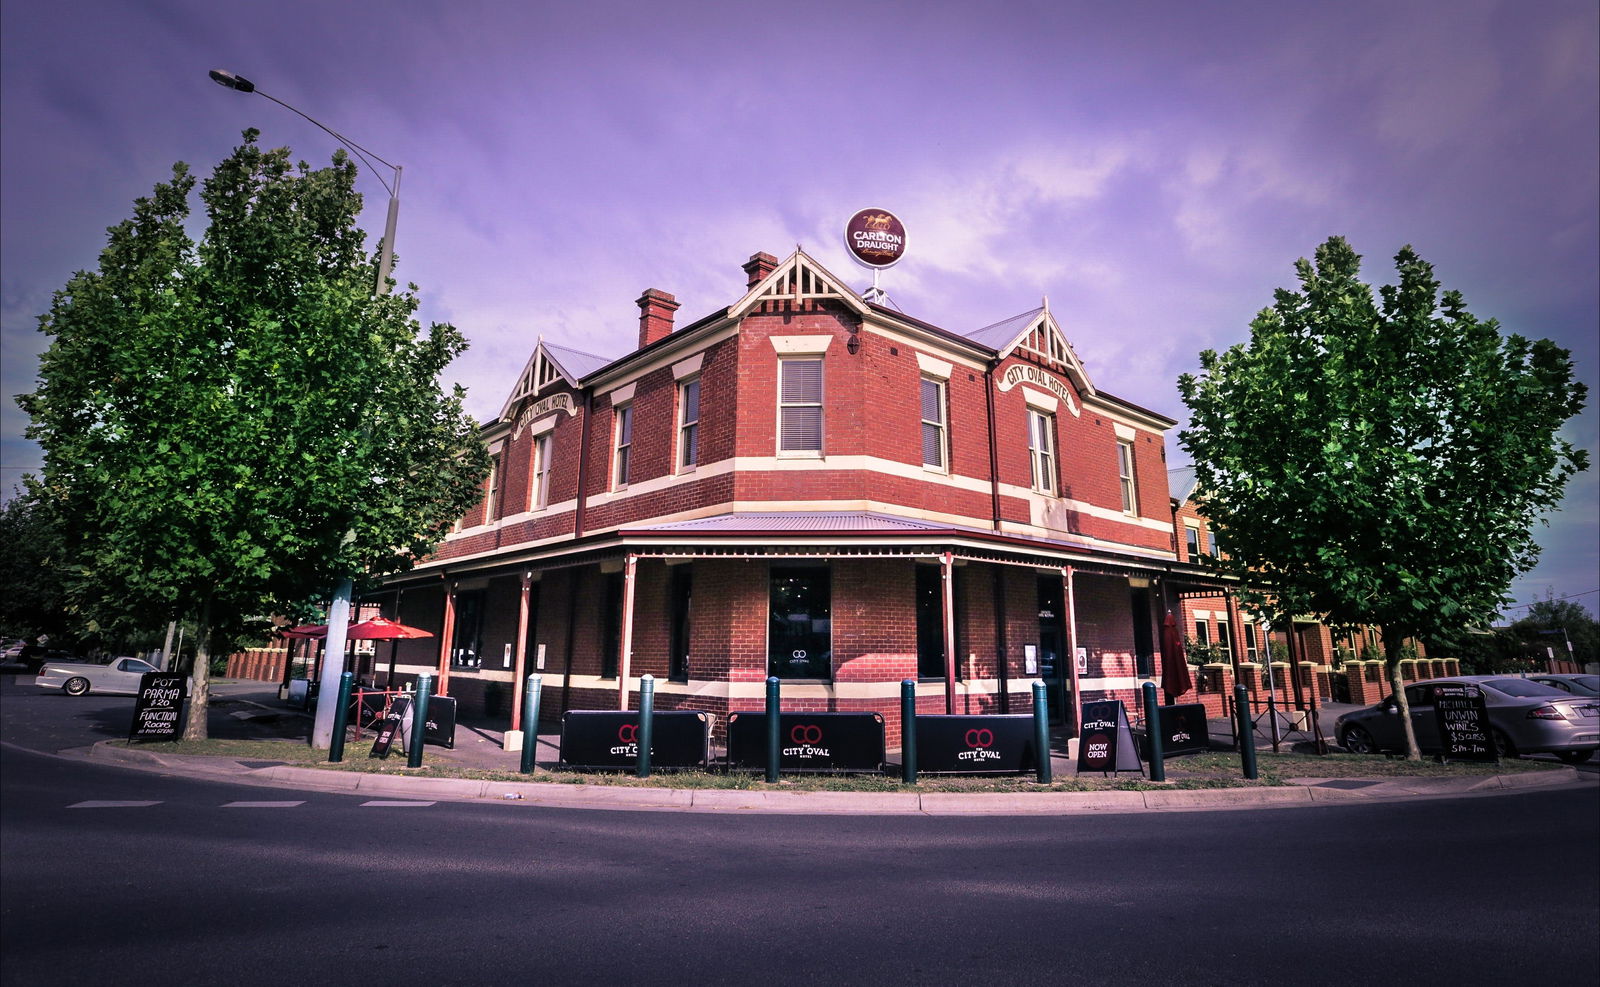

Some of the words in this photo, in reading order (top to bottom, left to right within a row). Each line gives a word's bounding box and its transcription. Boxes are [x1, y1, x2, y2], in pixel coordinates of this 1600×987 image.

[853, 230, 902, 245] CARLTON
[857, 240, 899, 251] DRAUGHT
[1007, 366, 1024, 386] CITY
[1027, 367, 1047, 387] OVAL
[1049, 376, 1070, 406] HOTEL
[520, 406, 533, 428] CITY
[536, 399, 550, 415] OVAL
[551, 394, 568, 409] HOTEL
[152, 678, 180, 687] POT
[144, 688, 180, 700] PARMA
[140, 712, 178, 720] FUNCTION
[783, 747, 804, 756] CITY
[806, 747, 830, 757] OVAL
[1089, 743, 1108, 751] NOW
[958, 751, 978, 760] CITY
[979, 750, 1001, 760] OVAL
[1087, 750, 1107, 758] OPEN
